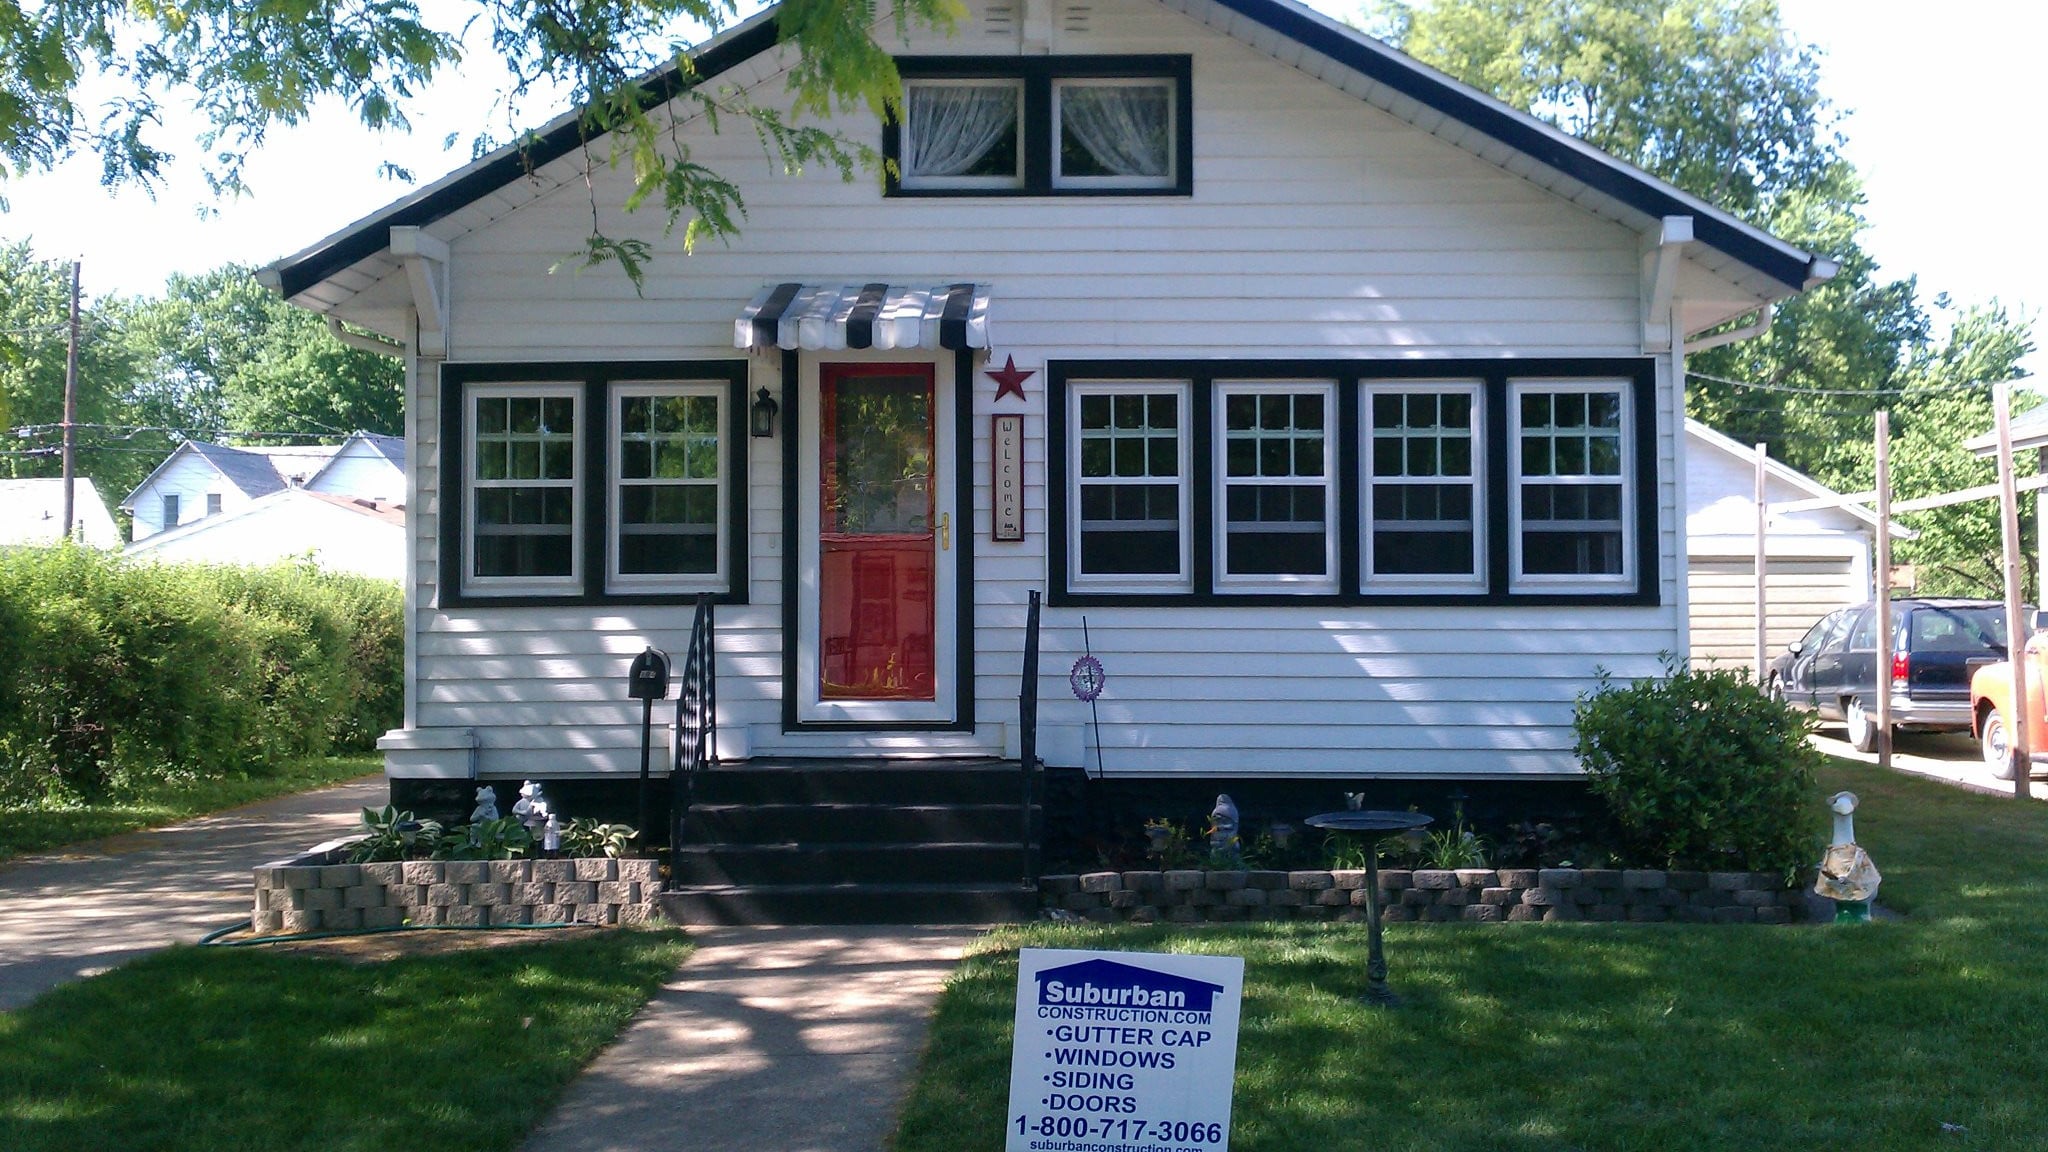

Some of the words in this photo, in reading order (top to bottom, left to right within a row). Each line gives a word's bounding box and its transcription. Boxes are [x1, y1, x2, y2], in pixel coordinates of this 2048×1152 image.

[1046, 981, 1186, 1008] Suburban
[1038, 1006, 1211, 1025] CONSTRUCTION.COM
[1055, 1025, 1153, 1045] GUTTER
[1161, 1030, 1212, 1047] CAP
[1055, 1048, 1176, 1069] WINDOWS
[1052, 1071, 1134, 1090] SIDING
[1050, 1094, 1137, 1113] DOORS
[1015, 1115, 1222, 1144] 1-800-717-3066
[1030, 1140, 1203, 1152] suburbanconstructioncom
